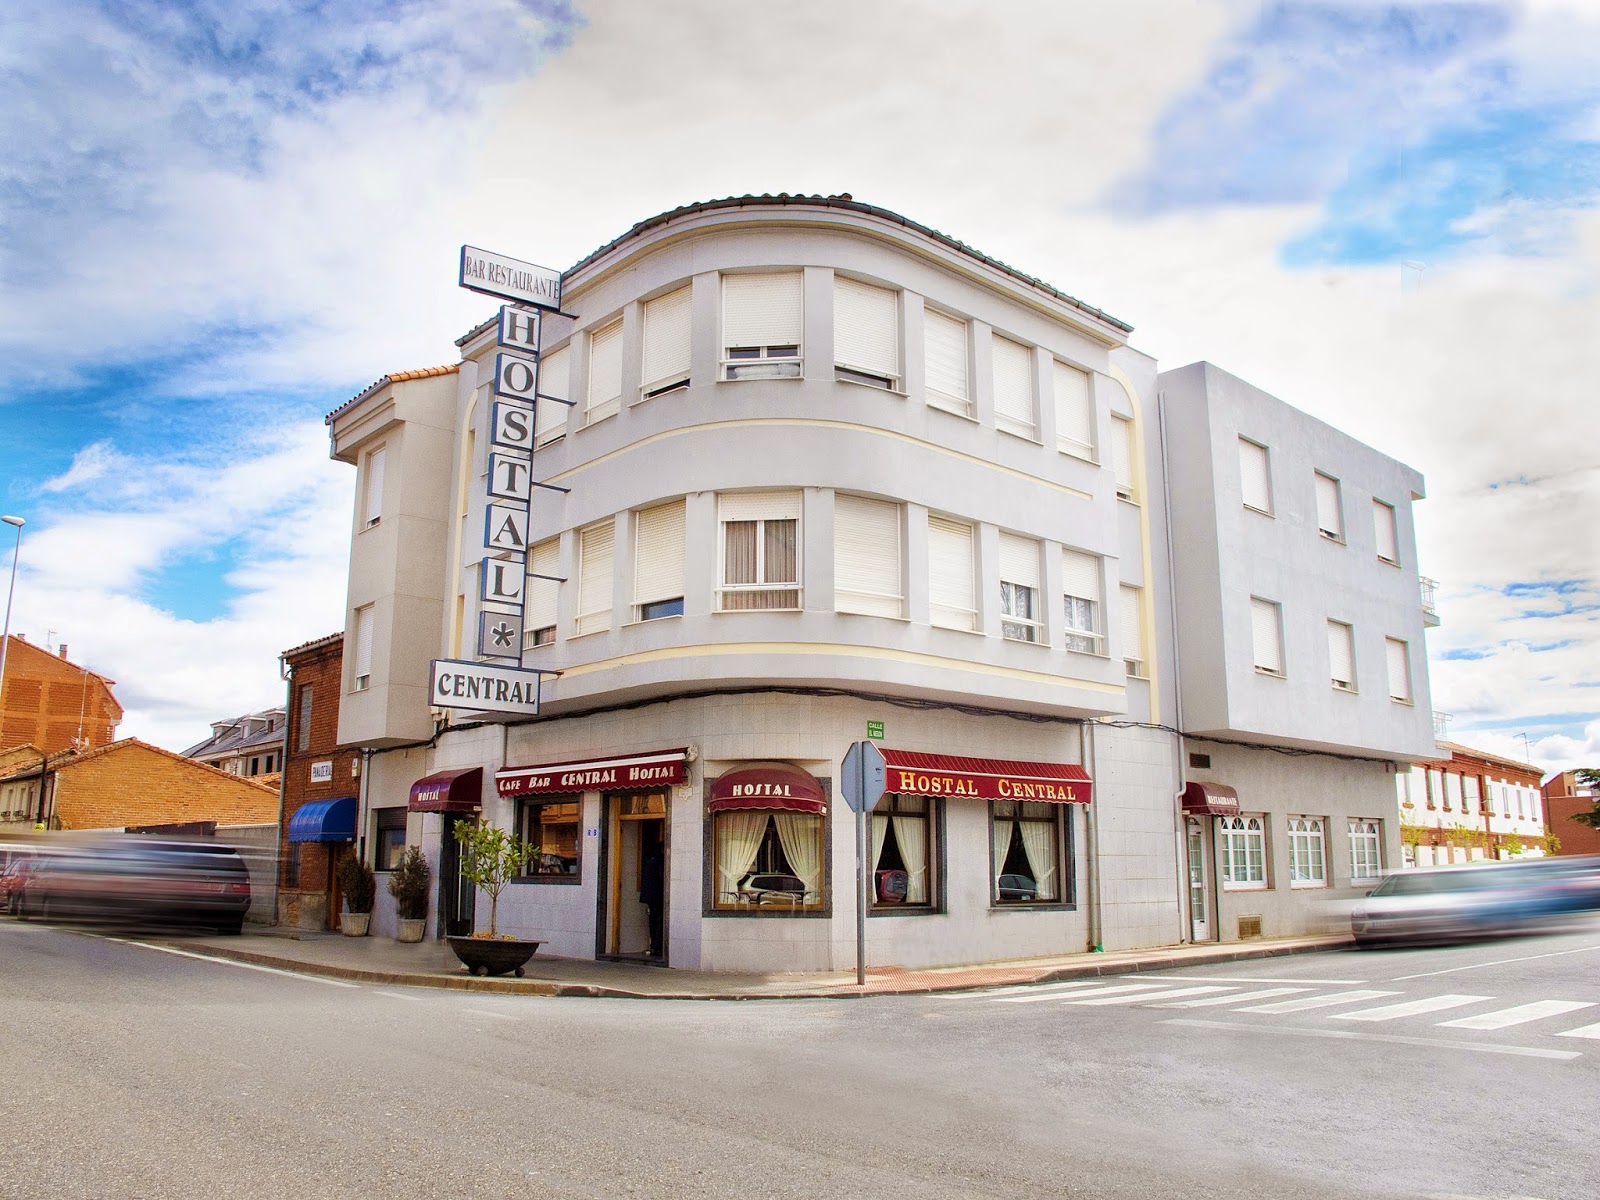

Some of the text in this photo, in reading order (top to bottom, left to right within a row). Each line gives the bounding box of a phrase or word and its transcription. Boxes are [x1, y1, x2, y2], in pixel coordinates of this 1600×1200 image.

[466, 256, 560, 300] BAR RESTAURANTE
[492, 311, 536, 598] HOSTAL
[438, 672, 536, 705] CENTRAL
[869, 722, 883, 730] CALLE
[561, 769, 617, 786] CENTRAL
[629, 765, 675, 781] HOSTAL
[899, 771, 1076, 800] HOSTAL CENTRAL
[418, 791, 439, 802] HOSTAL
[733, 783, 791, 797] HOSTAL
